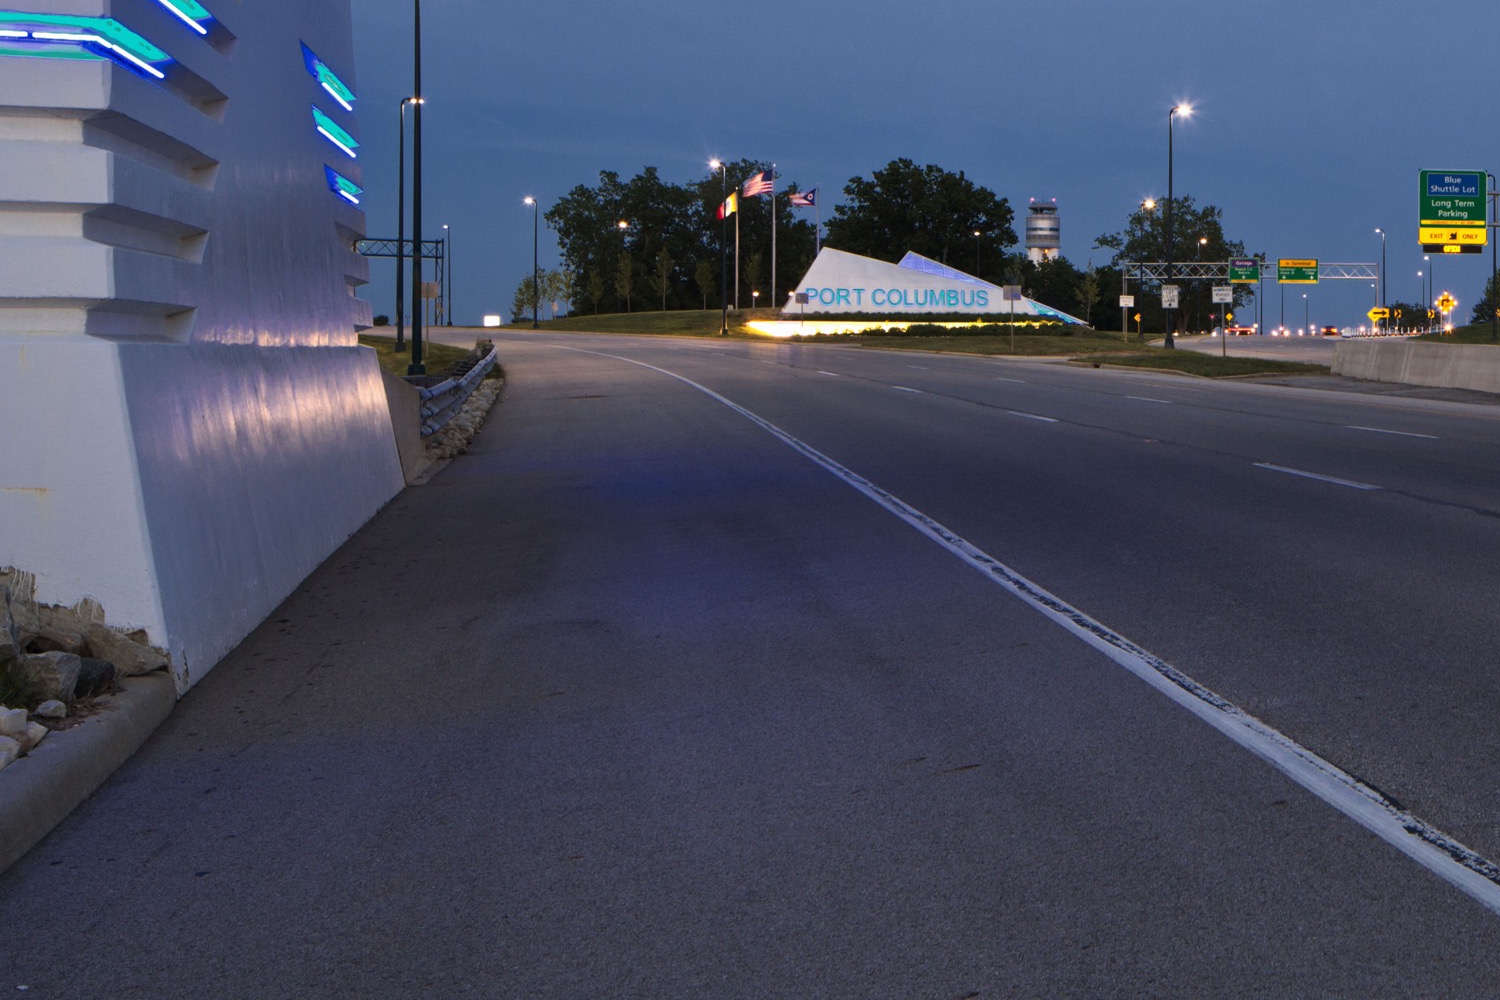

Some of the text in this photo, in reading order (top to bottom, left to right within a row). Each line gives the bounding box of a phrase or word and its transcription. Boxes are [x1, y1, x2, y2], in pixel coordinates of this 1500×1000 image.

[1444, 176, 1462, 184] Blue
[1430, 185, 1460, 193] Shuttle
[1431, 199, 1475, 209] Long Term
[1438, 209, 1468, 219] Parking
[805, 287, 989, 308] PORT COLUMBUS
